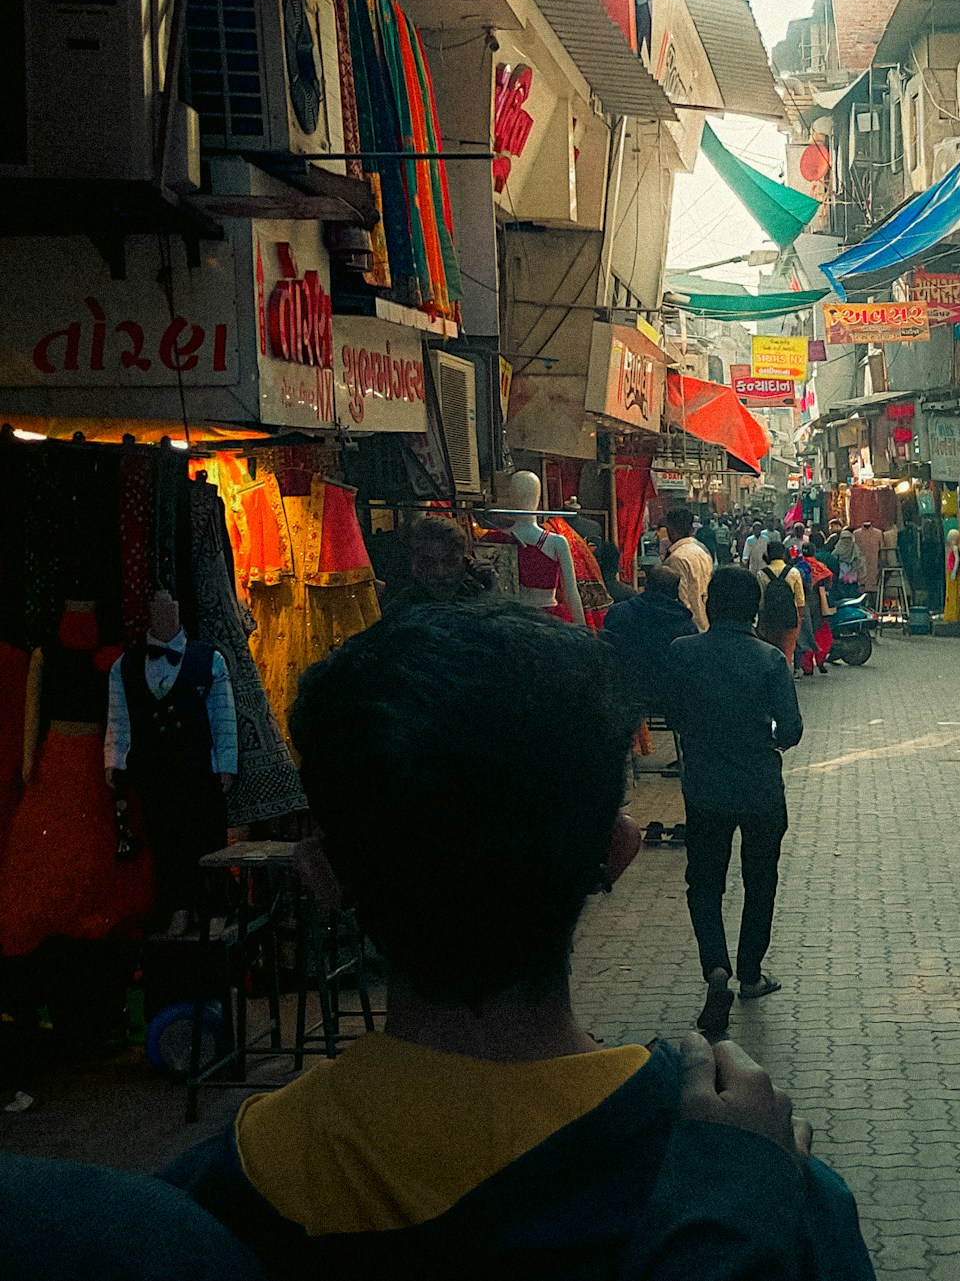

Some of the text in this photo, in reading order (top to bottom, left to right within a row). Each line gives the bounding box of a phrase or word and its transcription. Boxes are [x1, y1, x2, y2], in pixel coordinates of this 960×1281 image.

[842, 306, 925, 326] અવસર
[33, 297, 228, 373] તોરણ
[736, 380, 791, 393] કન્યાદાન
